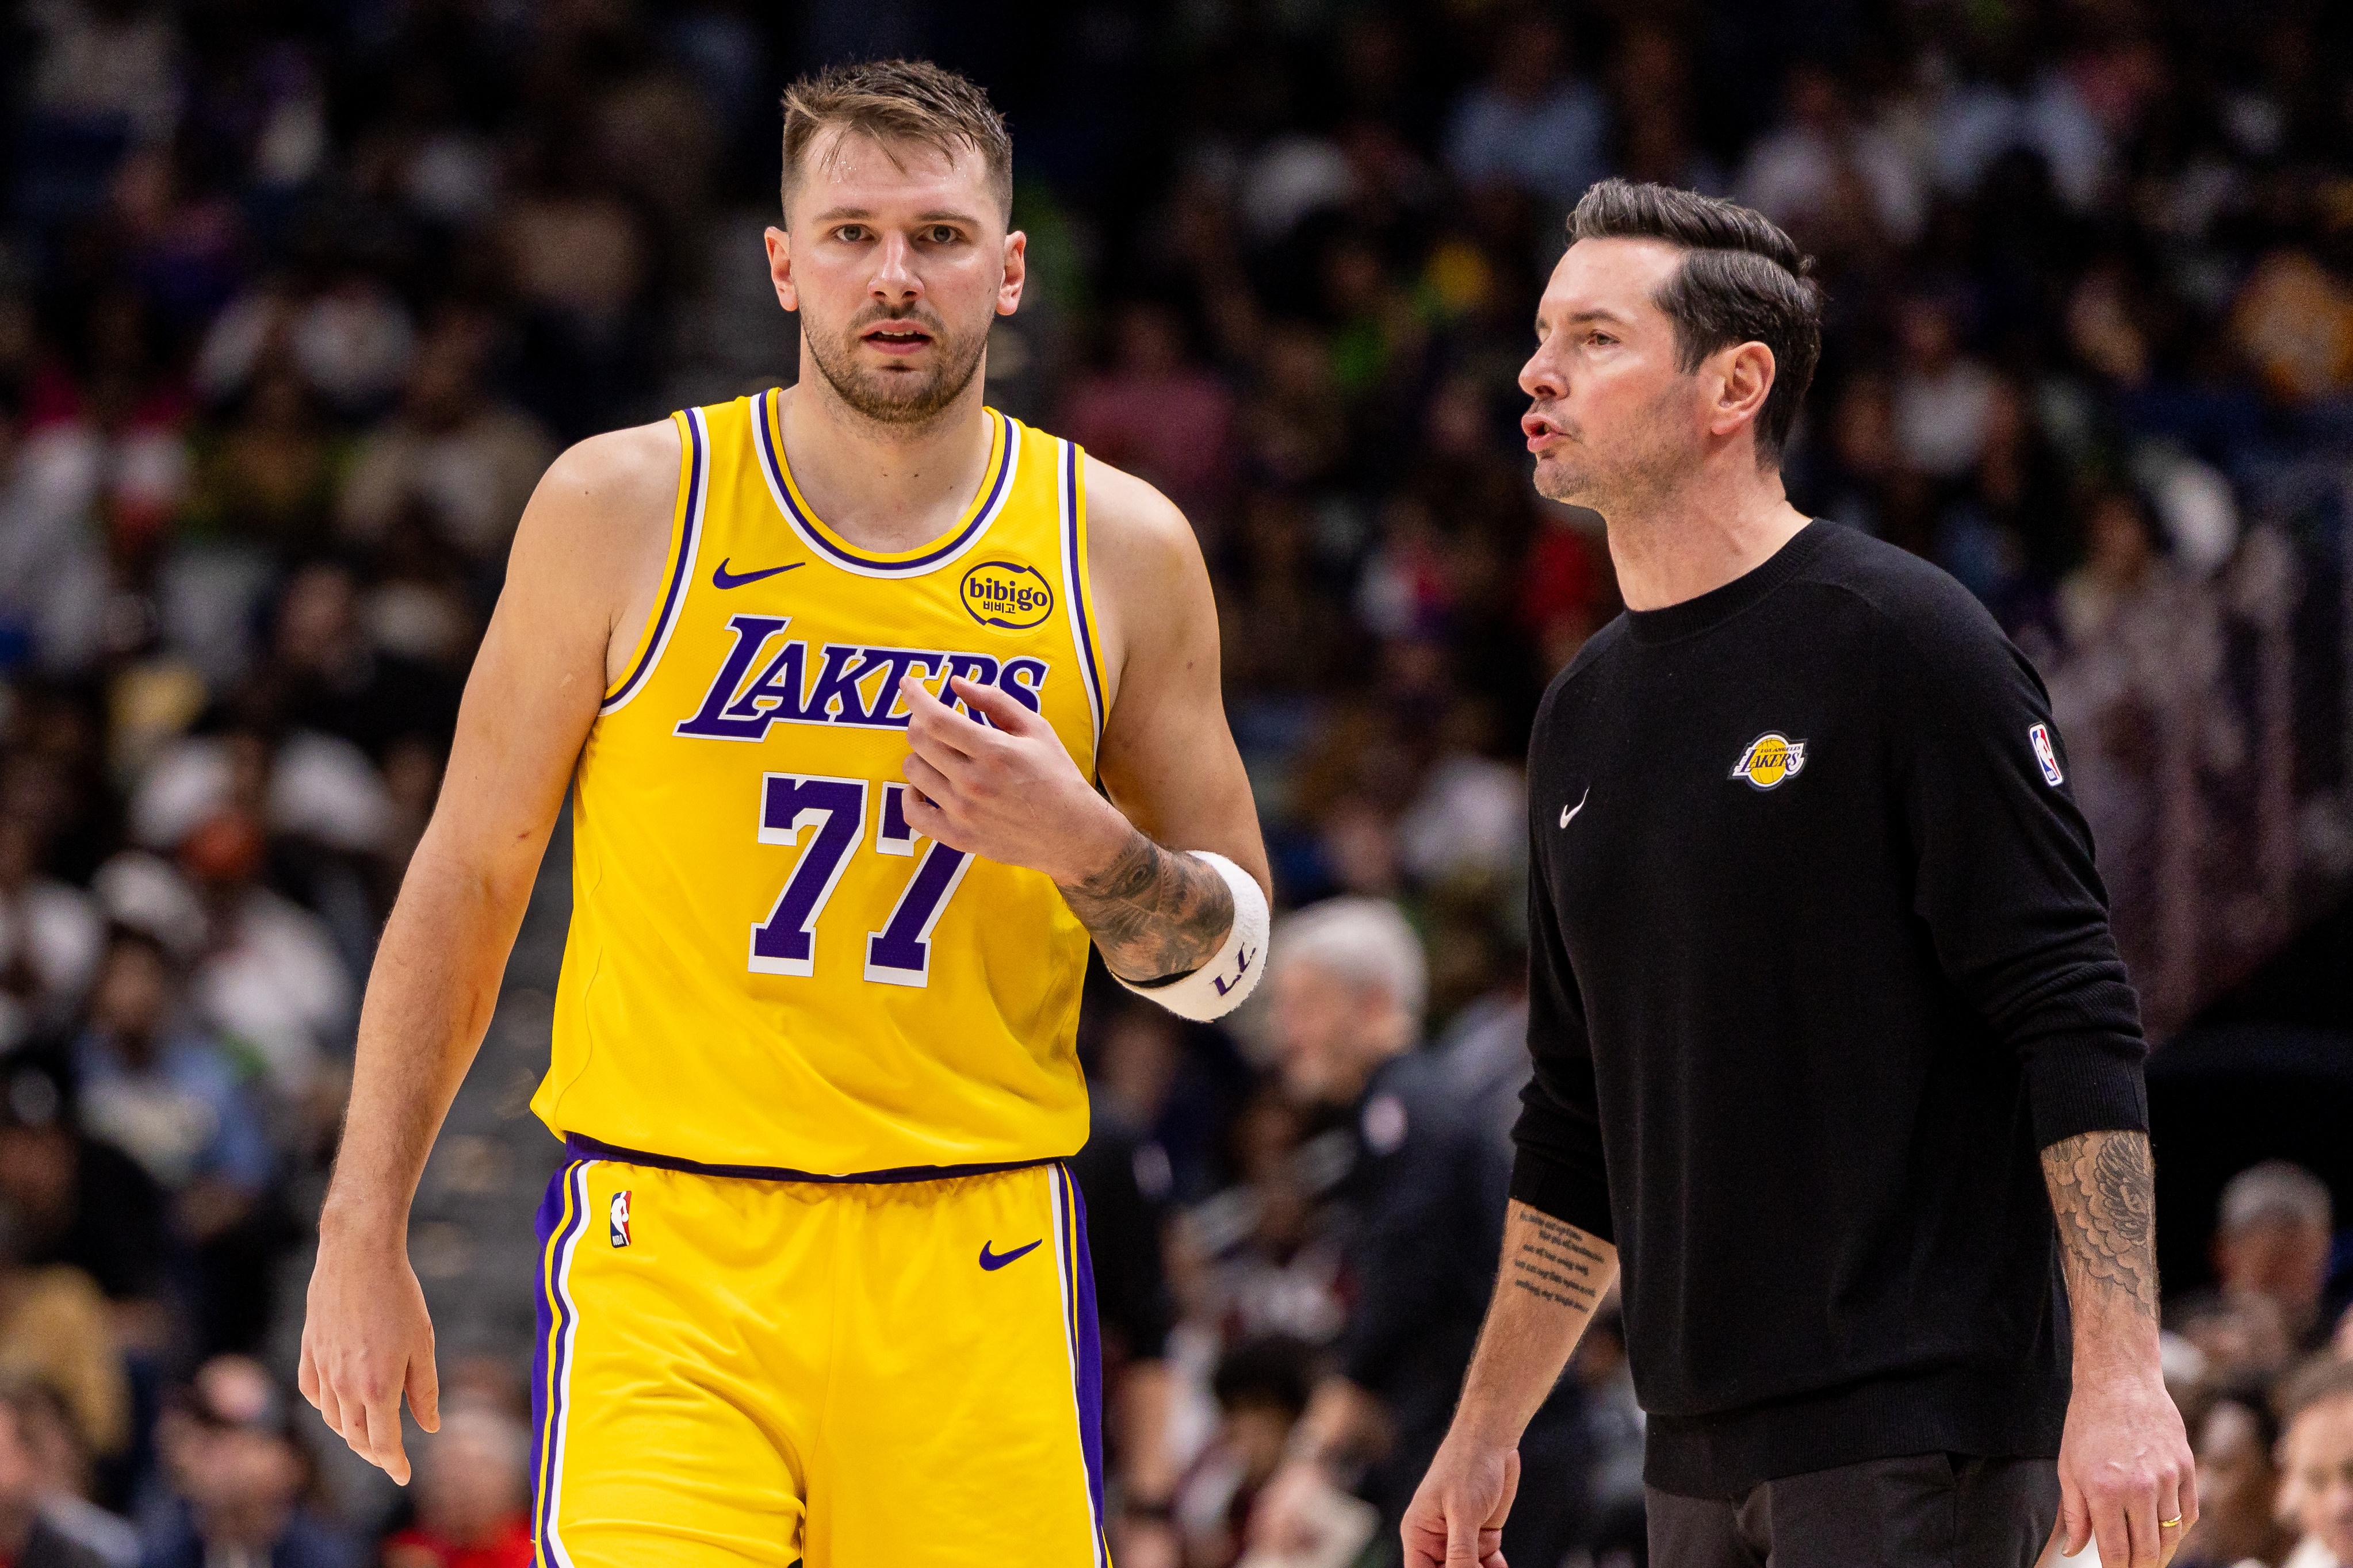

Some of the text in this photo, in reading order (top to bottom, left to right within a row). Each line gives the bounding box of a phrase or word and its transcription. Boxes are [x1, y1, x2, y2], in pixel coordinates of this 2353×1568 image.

[970, 577, 1047, 611] bibigo
[983, 601, 1016, 614] 비비고
[674, 613, 1050, 743] LAKERS
[1737, 749, 1800, 772] LAKERS
[748, 771, 977, 988] 77
[613, 1235, 624, 1245] NBA
